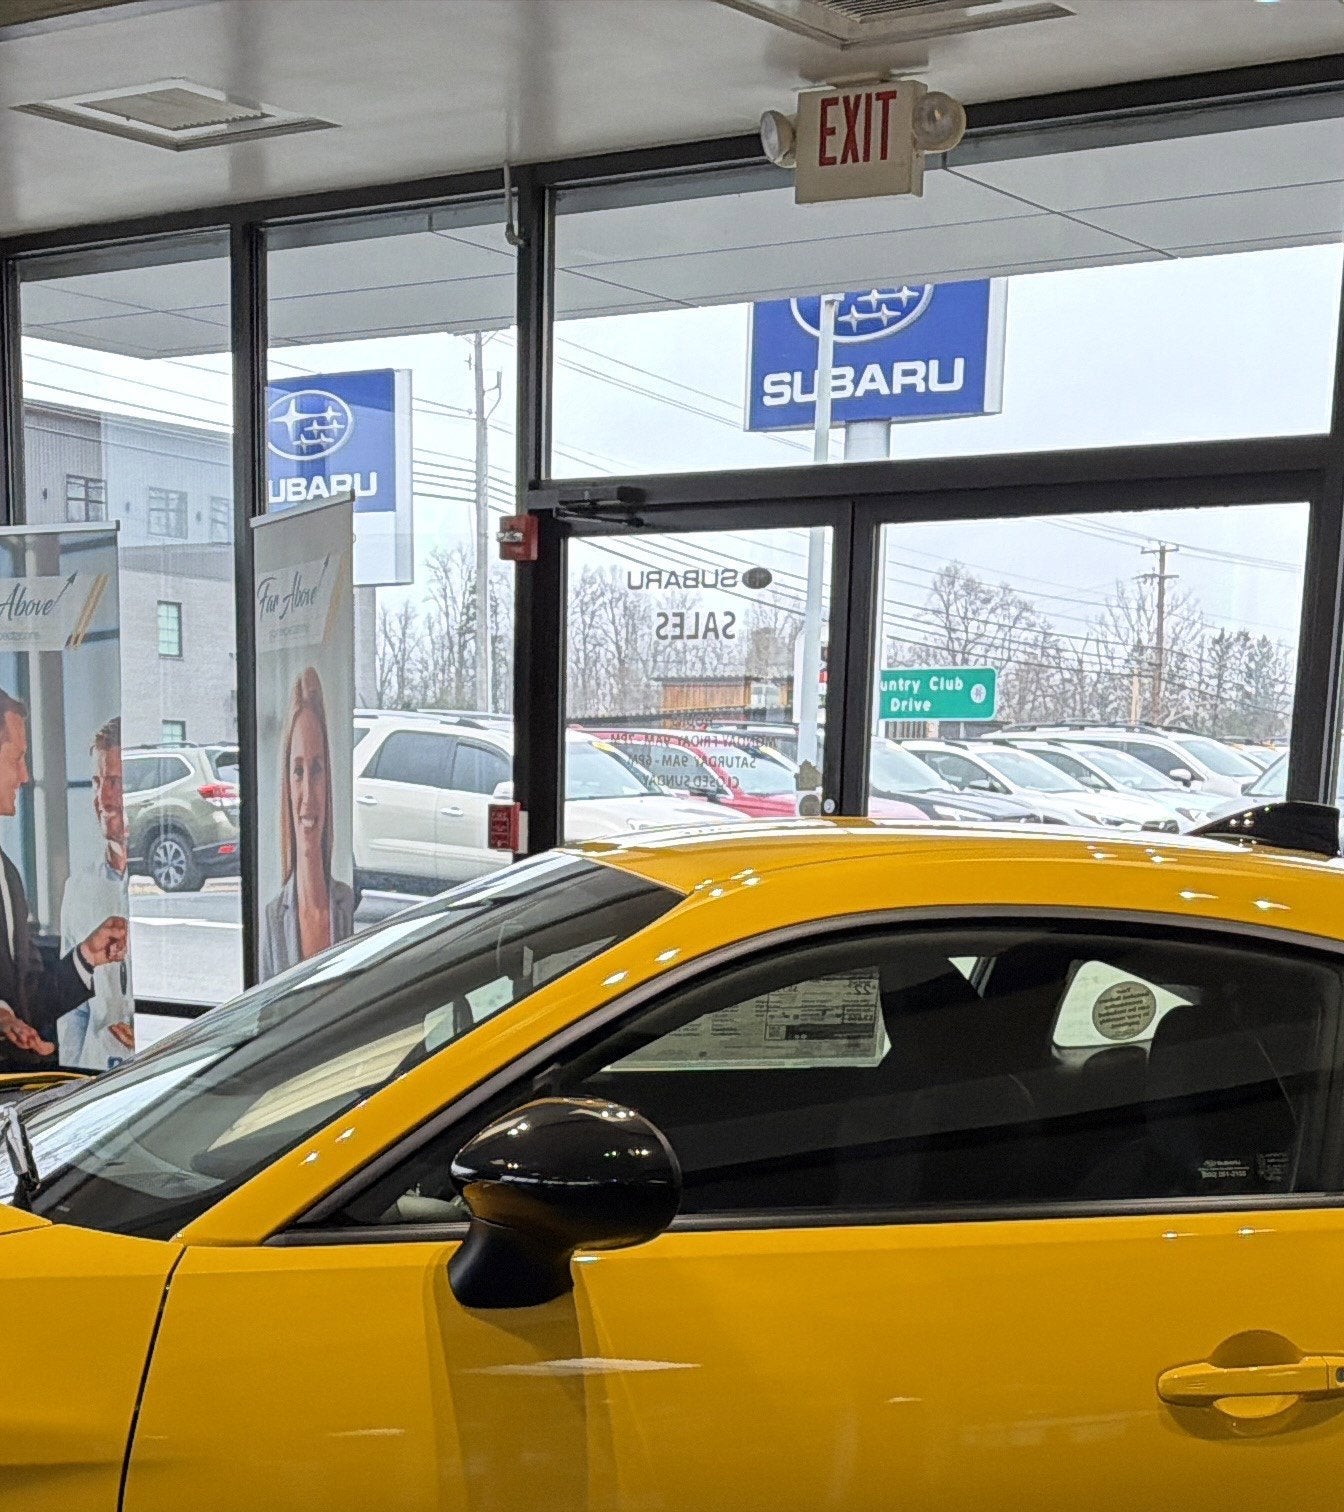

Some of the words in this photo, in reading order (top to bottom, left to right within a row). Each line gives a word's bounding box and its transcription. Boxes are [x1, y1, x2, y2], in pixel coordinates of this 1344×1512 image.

[819, 91, 897, 167] EXIT
[763, 358, 965, 406] SUBARU
[268, 472, 378, 503] UBARU
[880, 678, 921, 694] untry
[929, 676, 964, 691] Club
[890, 698, 932, 712] Drive
